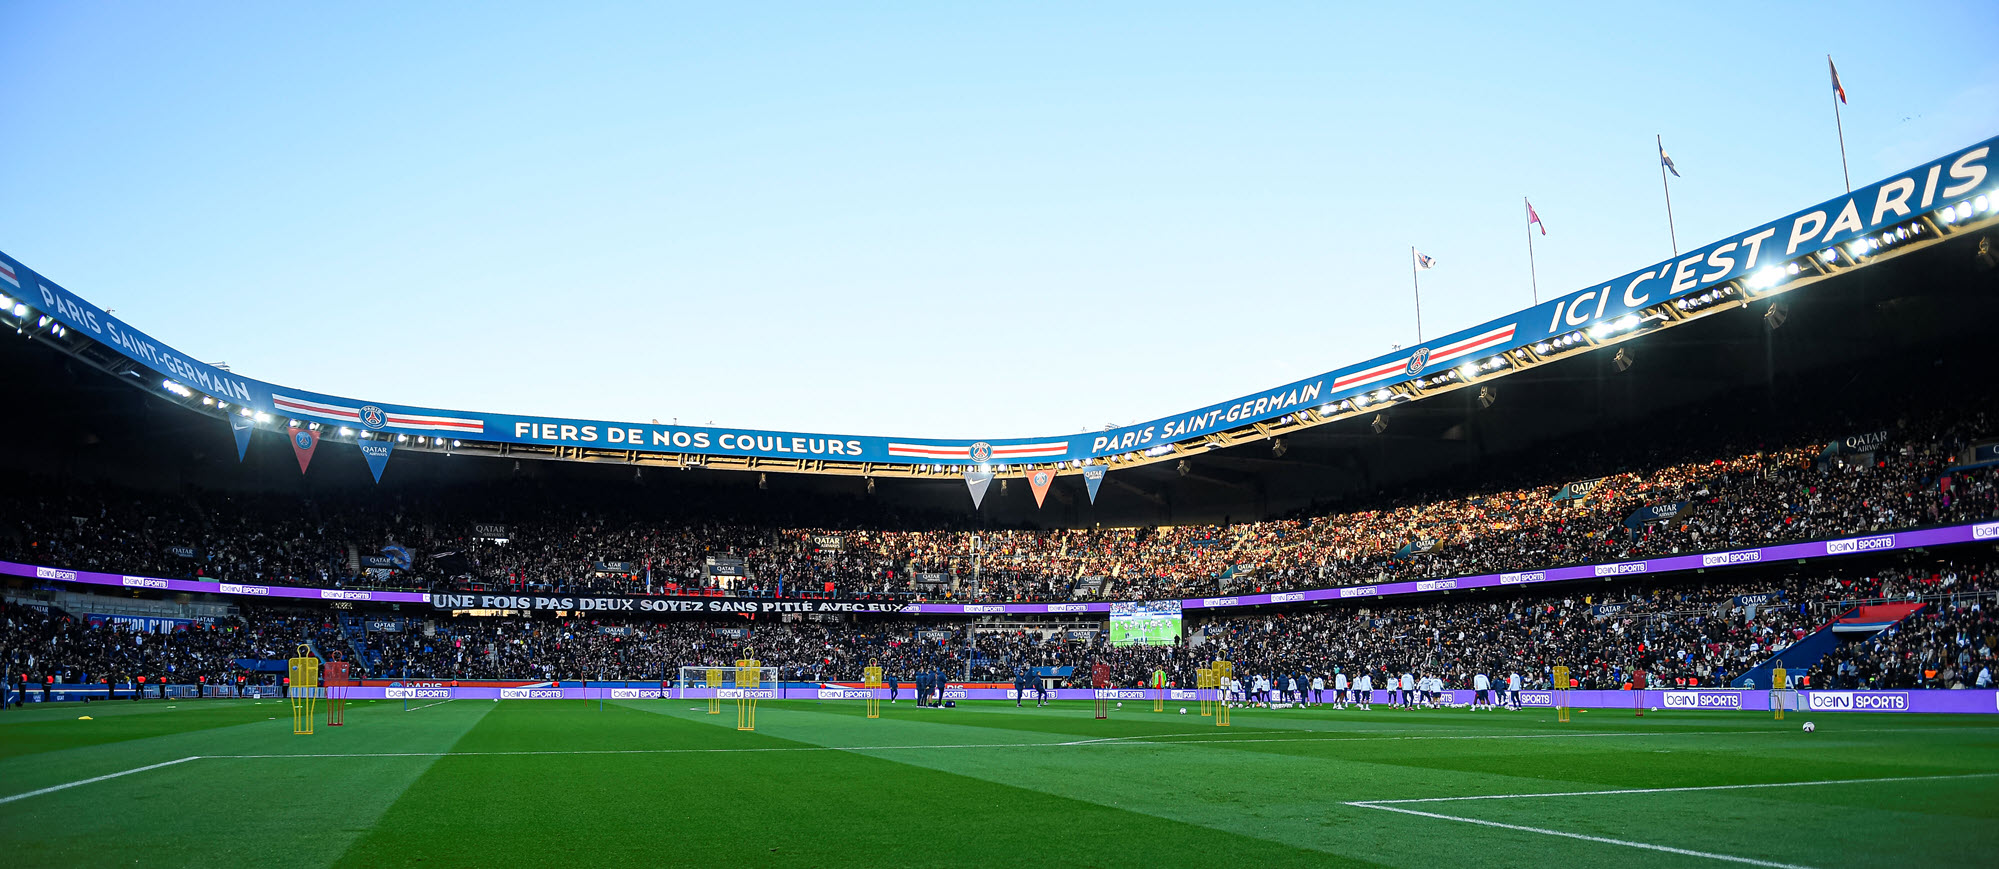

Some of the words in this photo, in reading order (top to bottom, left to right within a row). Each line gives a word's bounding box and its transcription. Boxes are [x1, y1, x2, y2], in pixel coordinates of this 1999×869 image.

[1548, 285, 1612, 334] ICI
[1622, 227, 1776, 309] C'EST
[1785, 146, 1990, 257] PARIS
[38, 284, 102, 333] PARIS
[106, 322, 251, 401] SAINT-GERMAIN
[1092, 426, 1155, 454] PARIS
[1162, 381, 1323, 438] SAINT-GERMAIN
[515, 422, 598, 441] FIERS
[607, 427, 644, 444] DE
[652, 431, 710, 448] NOS
[718, 434, 863, 455] COULEURS
[1847, 431, 1887, 448] QATAR
[1652, 503, 1677, 514] QATAR
[475, 525, 505, 533] QATAR
[814, 537, 840, 545] QATAR
[1416, 540, 1435, 548] QATAR
[1829, 541, 1855, 552] beIN
[1858, 537, 1892, 549] SPORTS
[1730, 551, 1759, 562] SPORTS
[1619, 563, 1645, 572] SPORTS
[1521, 572, 1545, 581] SPORTS
[433, 594, 475, 608] UNE
[481, 595, 530, 609] FOIS
[535, 597, 574, 610] PAS
[580, 598, 634, 610] DEUX
[640, 599, 703, 611] SOYEZ
[709, 600, 758, 612] SANS
[819, 602, 866, 611] AVEC
[868, 603, 903, 612] EUX
[1742, 595, 1767, 605] QATAR
[1600, 606, 1621, 614] QATAR
[502, 690, 527, 698] beIN
[531, 690, 561, 698] SPORTS
[613, 690, 637, 698] beIN
[820, 690, 842, 698] beIN
[1522, 693, 1550, 704] SPORTS
[1667, 693, 1696, 706] beIN
[1700, 695, 1738, 706] SPORTS
[1813, 694, 1850, 708] beIN
[1856, 695, 1904, 708] SPORTS
